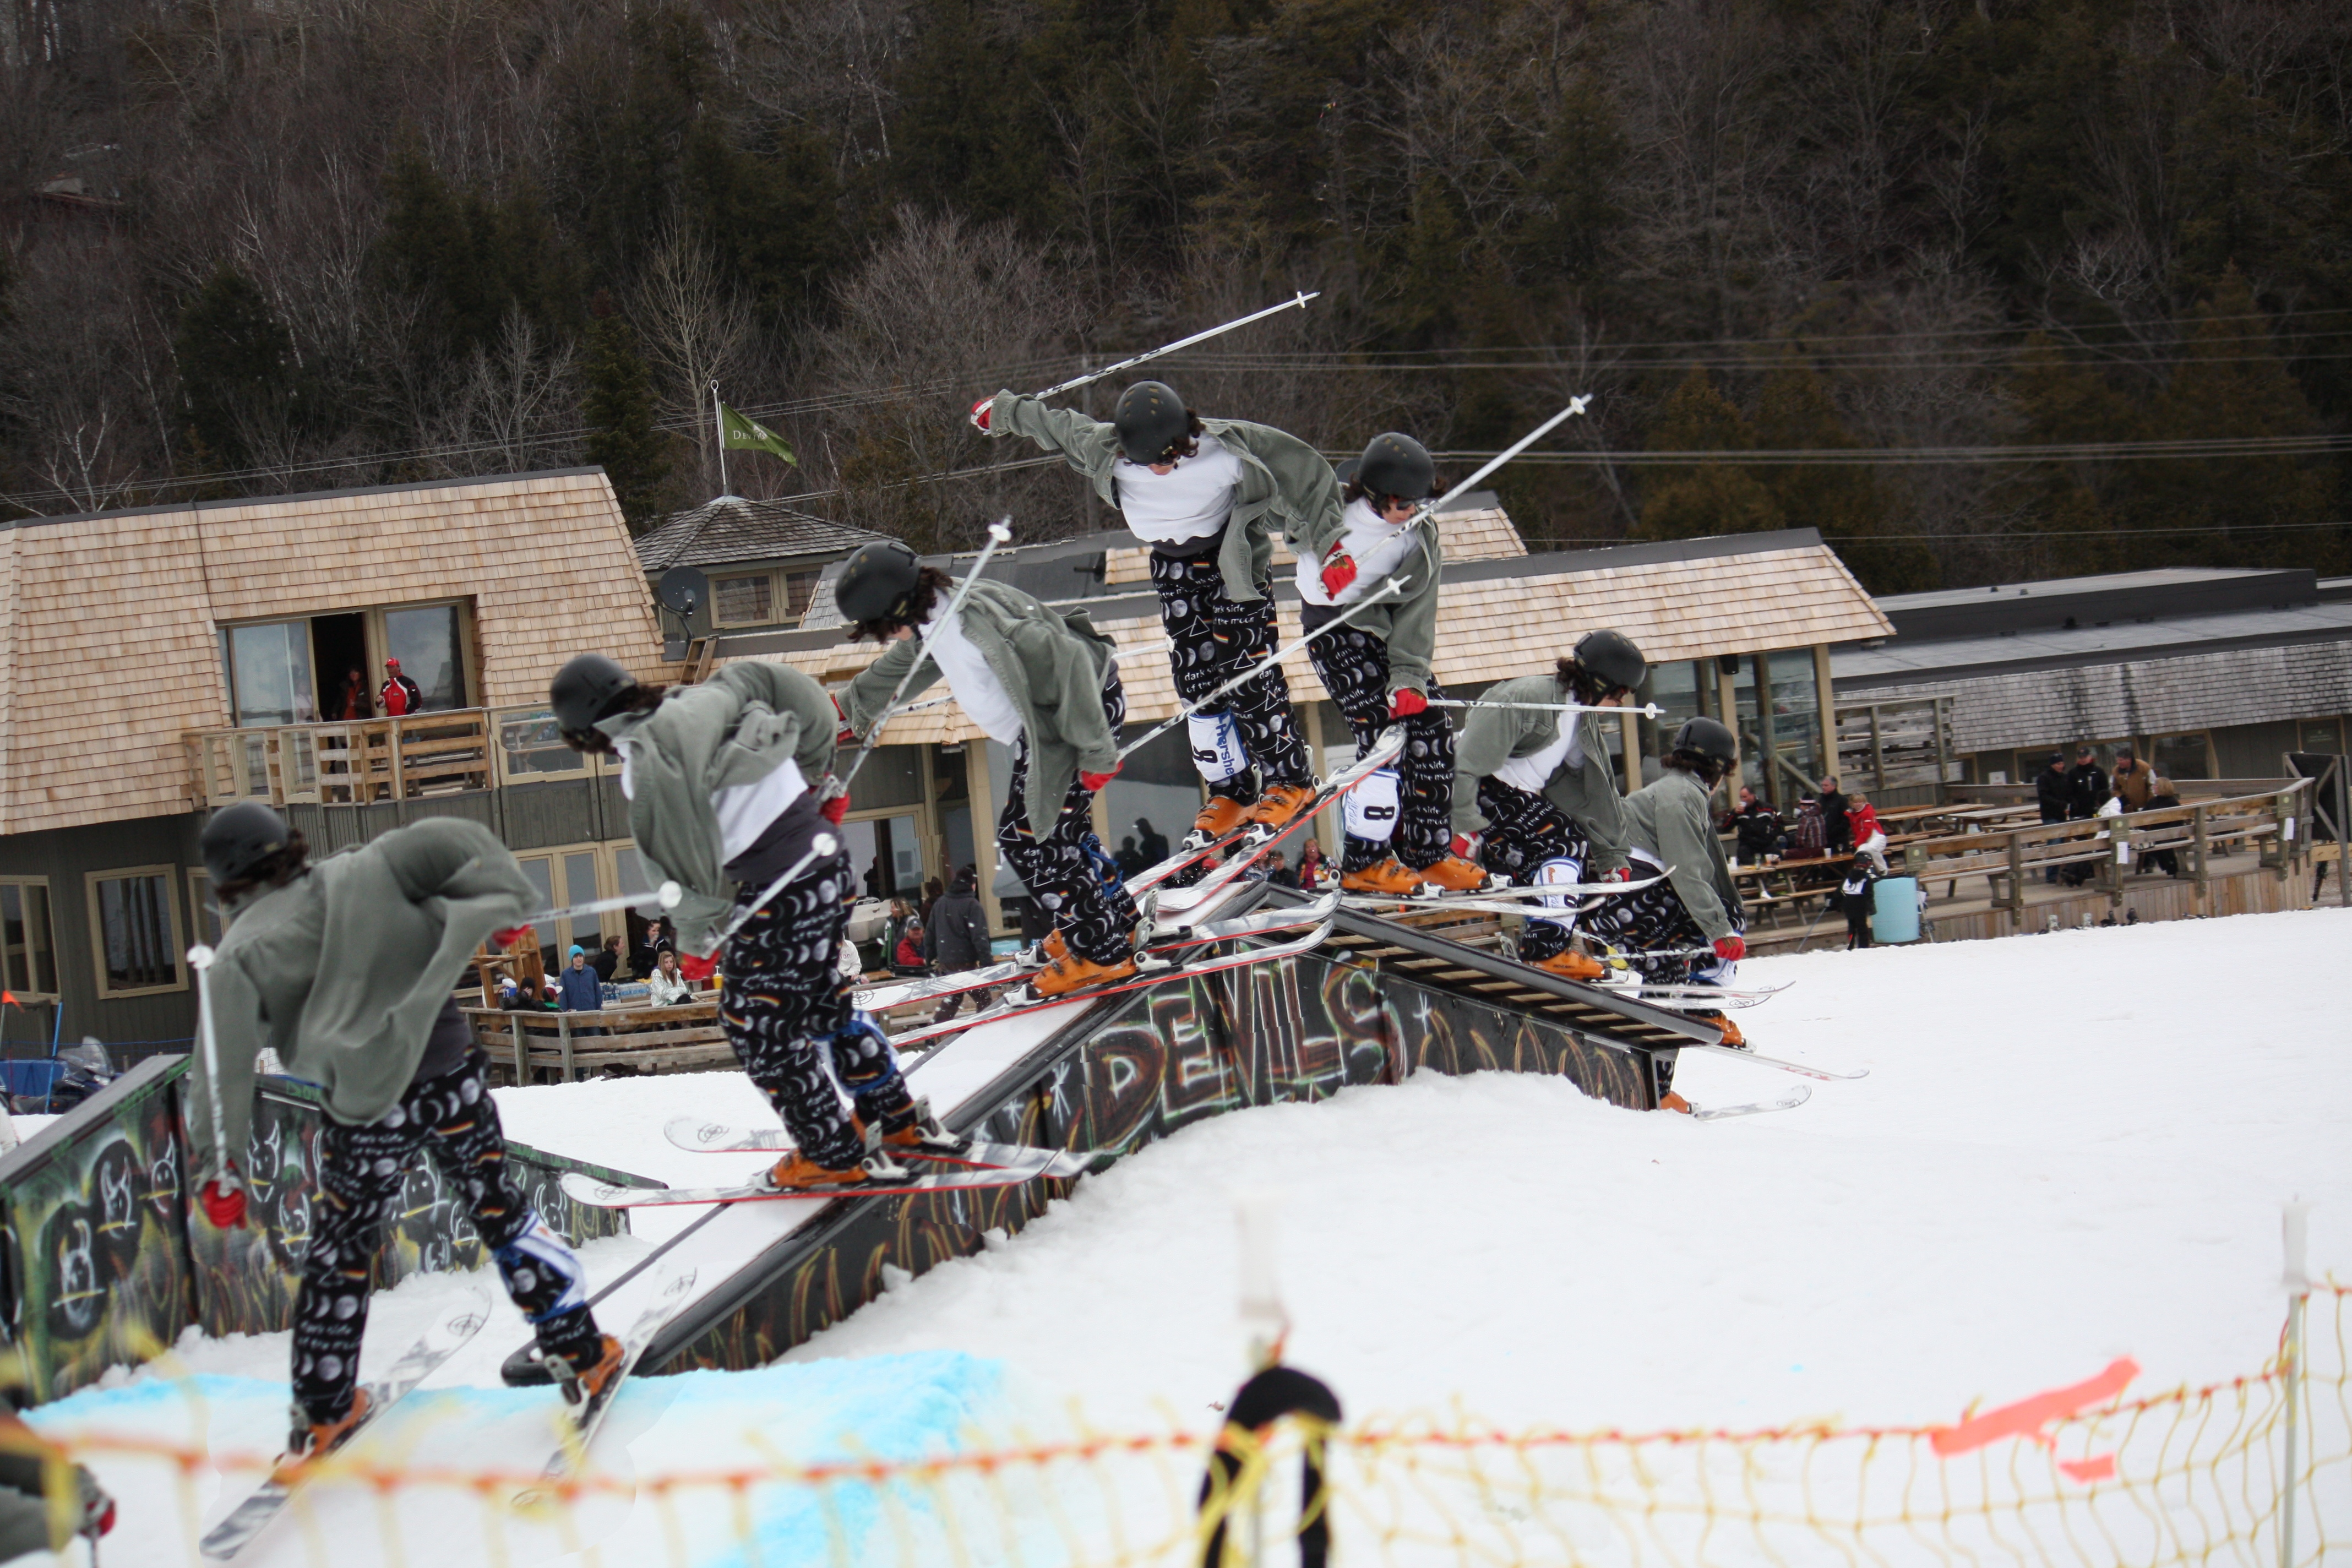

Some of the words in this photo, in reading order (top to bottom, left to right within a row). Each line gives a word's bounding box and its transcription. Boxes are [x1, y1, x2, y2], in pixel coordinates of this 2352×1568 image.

[1226, 605, 1245, 613] side
[1184, 669, 1205, 682] dark
[1259, 669, 1272, 679] dar
[1186, 684, 1196, 693] of
[1197, 681, 1212, 689] the
[1429, 760, 1446, 770] side
[1364, 805, 1395, 820] 8
[1423, 805, 1441, 815] side
[1023, 848, 1041, 857] dar
[1081, 941, 1407, 1152] DEVILS
